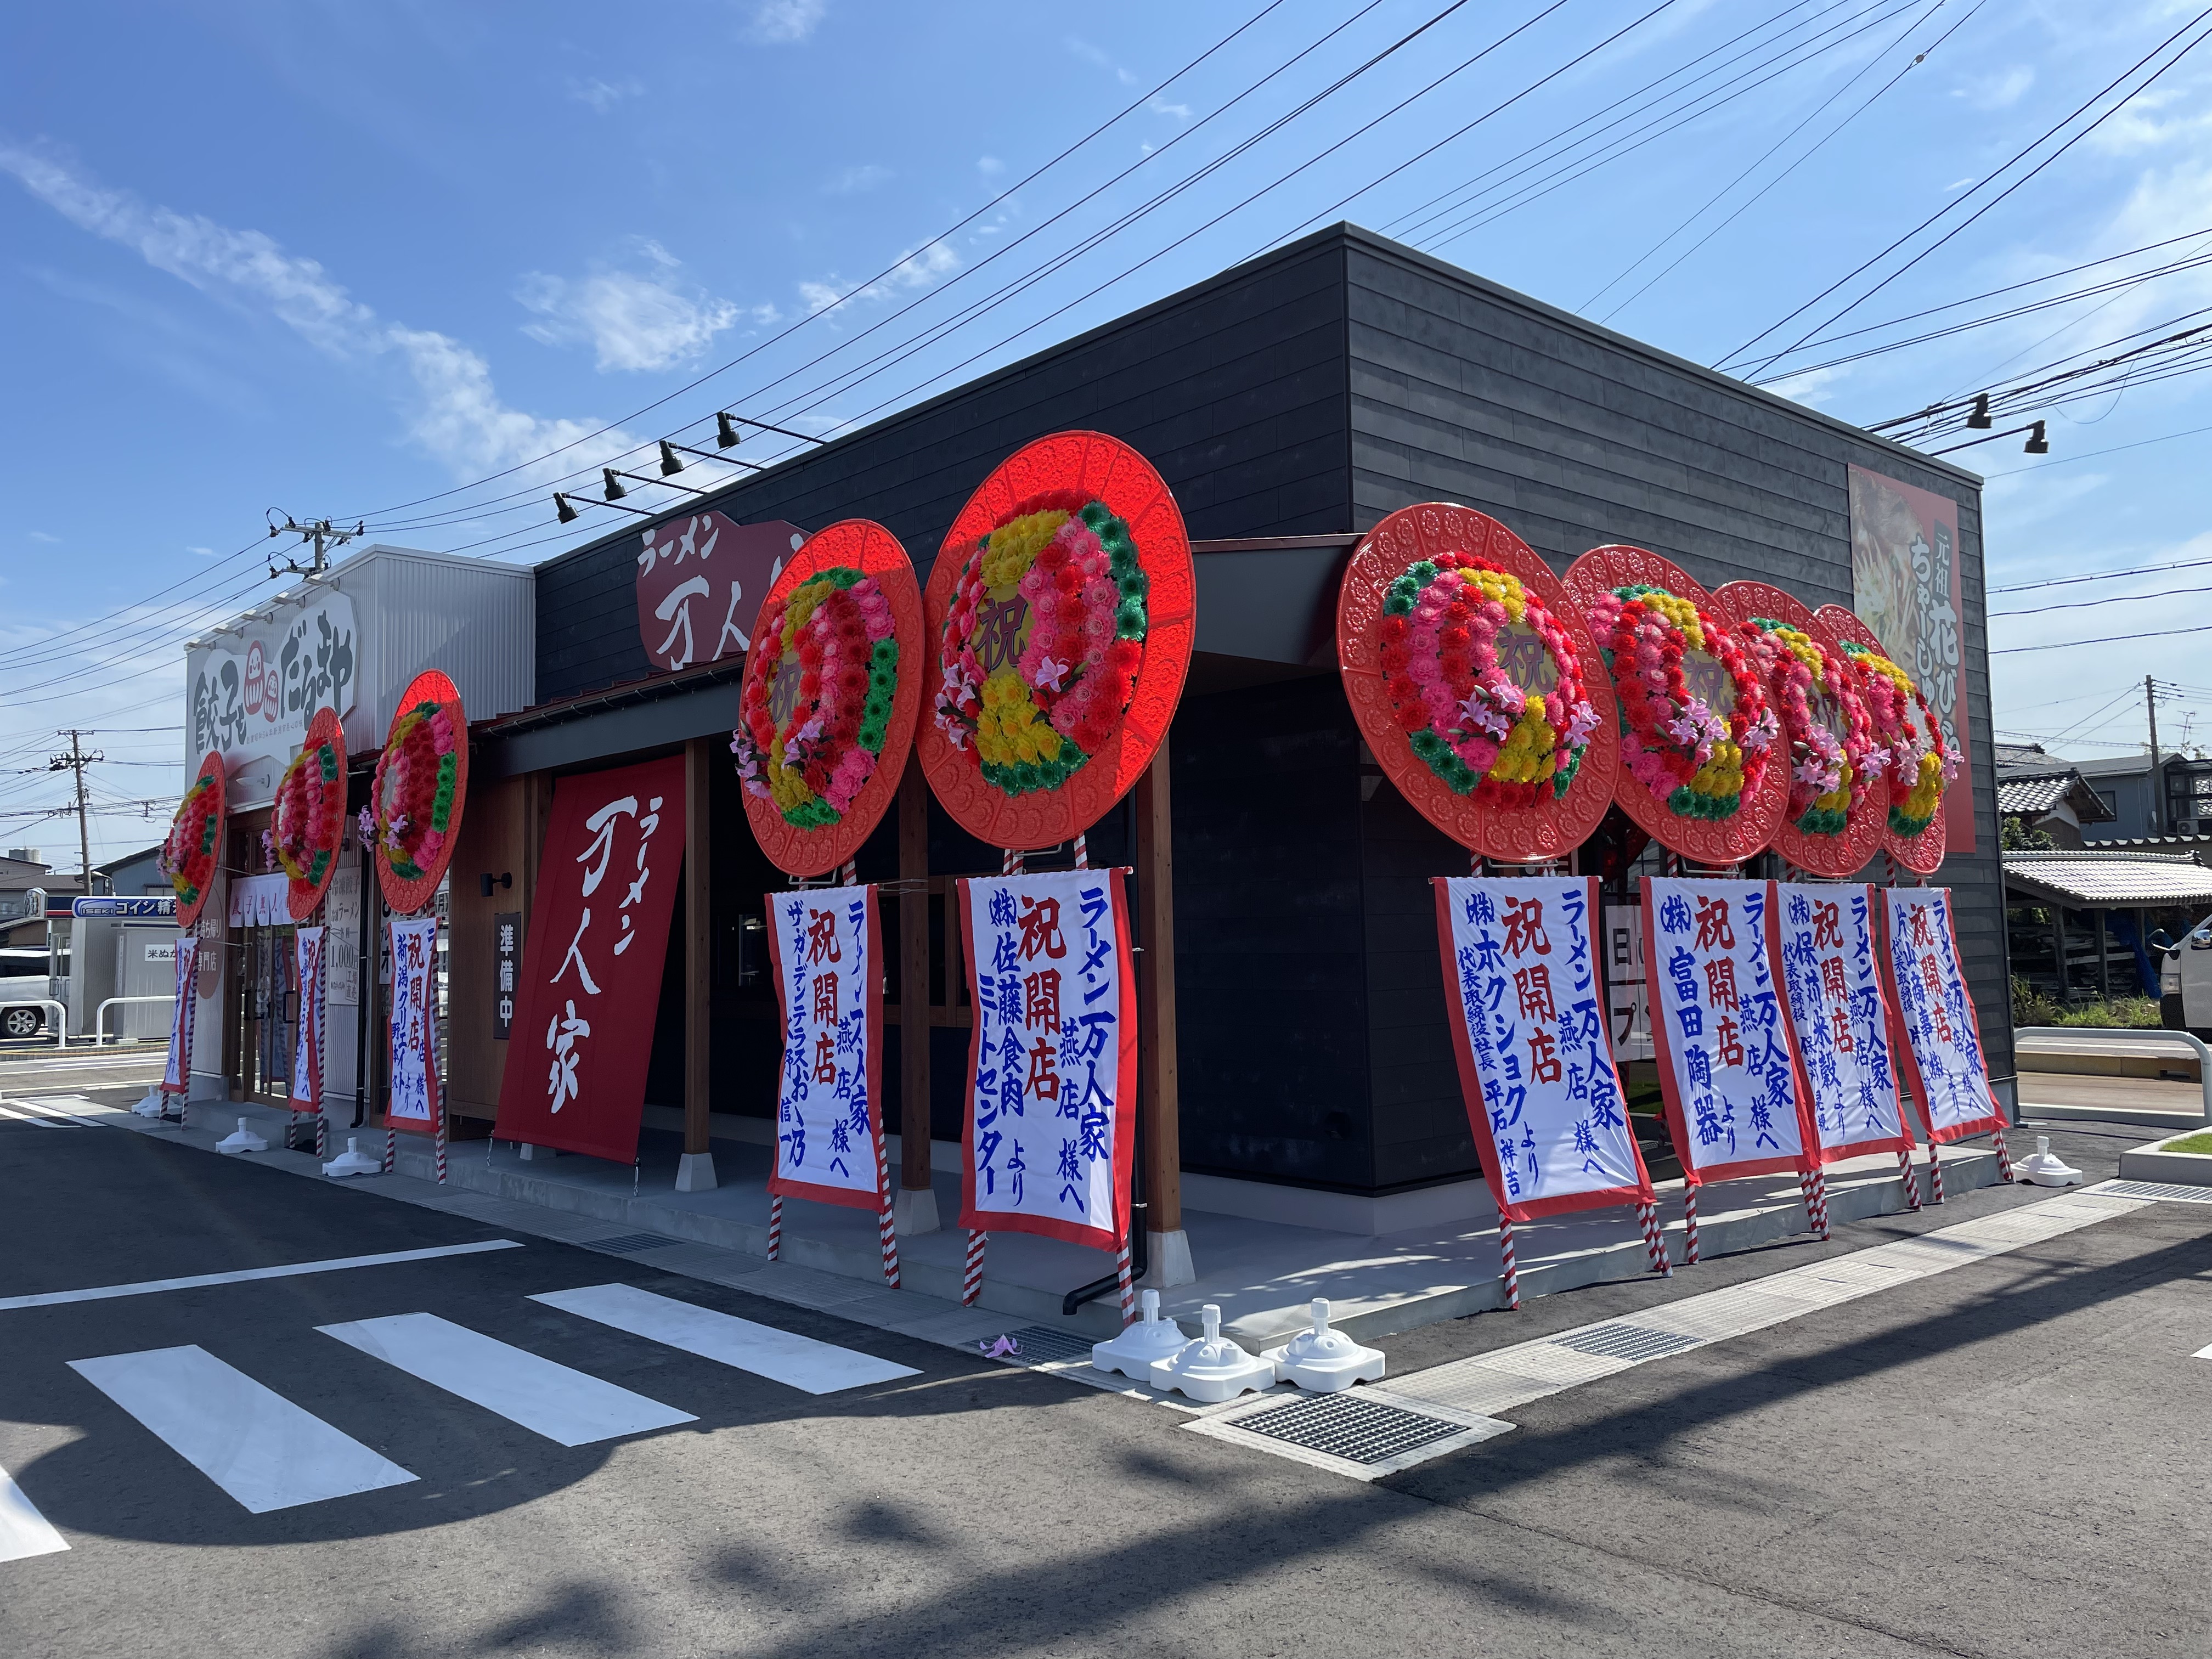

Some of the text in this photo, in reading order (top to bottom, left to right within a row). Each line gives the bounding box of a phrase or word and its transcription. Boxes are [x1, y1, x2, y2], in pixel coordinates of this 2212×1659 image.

[637, 515, 719, 577] ラーメン
[1934, 535, 1950, 599] 元祖
[766, 659, 802, 723] 祝
[974, 593, 1029, 673] 祝
[1496, 627, 1554, 694] 祝
[1682, 654, 1734, 715] 祝
[614, 795, 662, 955] ラーメン
[198, 951, 217, 972] 専門店
[407, 933, 425, 1052] 祝開店
[499, 924, 514, 1027] 準備中
[547, 795, 638, 1114] 万人家
[805, 908, 842, 1085] 祝開店
[1017, 894, 1066, 1101] 祝開店
[1077, 887, 1118, 1161] ラーメン万人家
[1458, 946, 1498, 1071] 代表取締役社長
[1501, 895, 1562, 1086] 祝開店
[1561, 889, 1624, 1130] ラーメン万人家
[1694, 895, 1744, 1068] 祝開店
[1742, 893, 1794, 1108] ラーメン万人家
[1782, 941, 1808, 1023] 代表取締役
[1812, 899, 1854, 1054] 祝開店
[1851, 895, 1894, 1091] ラーメン万人家
[1891, 937, 1916, 1013] 代表取締役
[1909, 902, 1952, 1044] 祝開店
[1933, 900, 1984, 1075] ラーメン万人家
[975, 973, 1002, 1195] ミートセンター
